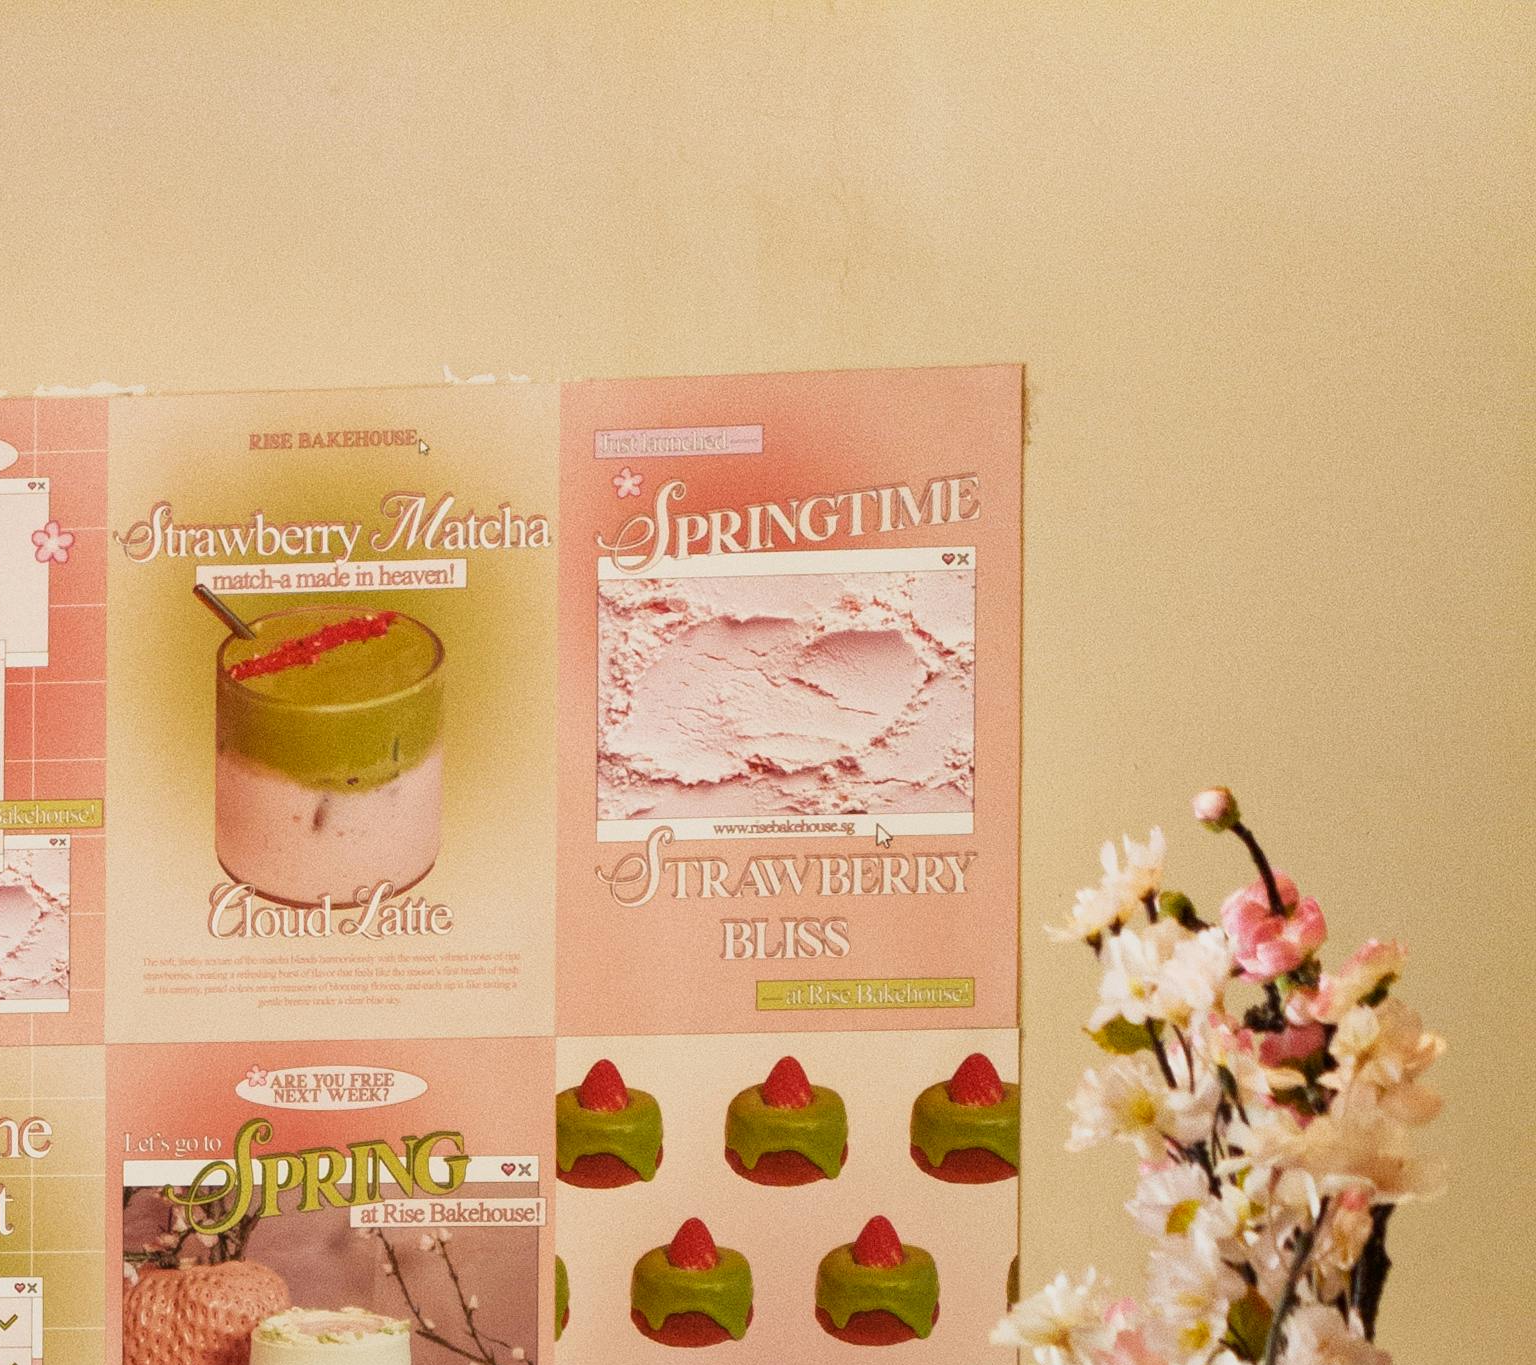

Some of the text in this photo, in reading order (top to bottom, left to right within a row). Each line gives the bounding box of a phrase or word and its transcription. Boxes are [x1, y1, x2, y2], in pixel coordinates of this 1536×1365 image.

[249, 429, 417, 450] RISE BAKEHOUSE
[600, 431, 728, 453] Just launched
[113, 490, 552, 566] Strawberry Matcha
[595, 474, 981, 575] SPRINGTIME
[212, 562, 455, 590] match-a made in heaven!
[714, 820, 855, 836] www.risebakehouse.sg
[595, 825, 978, 909] STRAWBERRY
[207, 879, 455, 941] Cloud Latte
[719, 917, 851, 960] BLISS
[786, 982, 969, 1005] at Rise Bakehouse!
[270, 1072, 395, 1089] ARE YOU FREE
[273, 1088, 390, 1103] NEXT WEEK?
[175, 1137, 199, 1157] go
[202, 1135, 222, 1152] to
[164, 1117, 472, 1235] SPRING
[360, 1201, 541, 1223] at Rise Bakehouse!
